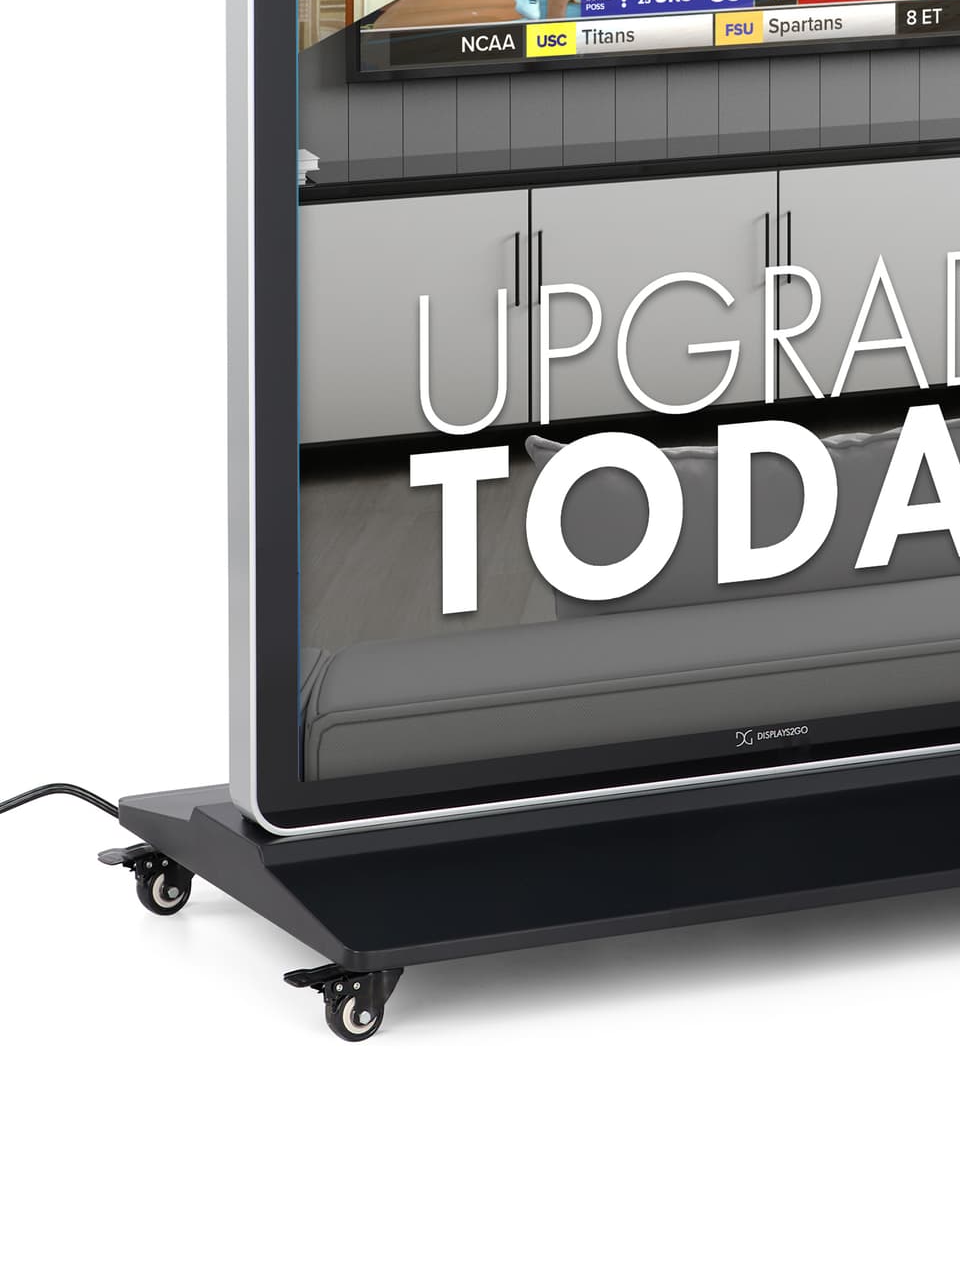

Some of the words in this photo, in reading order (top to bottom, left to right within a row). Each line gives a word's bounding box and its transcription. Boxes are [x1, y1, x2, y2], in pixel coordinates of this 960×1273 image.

[586, 3, 605, 11] POSS
[461, 34, 516, 53] NCAA
[537, 34, 567, 48] USC
[582, 28, 635, 45] Titans
[725, 23, 754, 36] FSU
[768, 17, 843, 37] Spartans
[906, 10, 917, 25] 8
[922, 8, 943, 25] ET
[757, 726, 809, 741] DISPLAYS2GO
